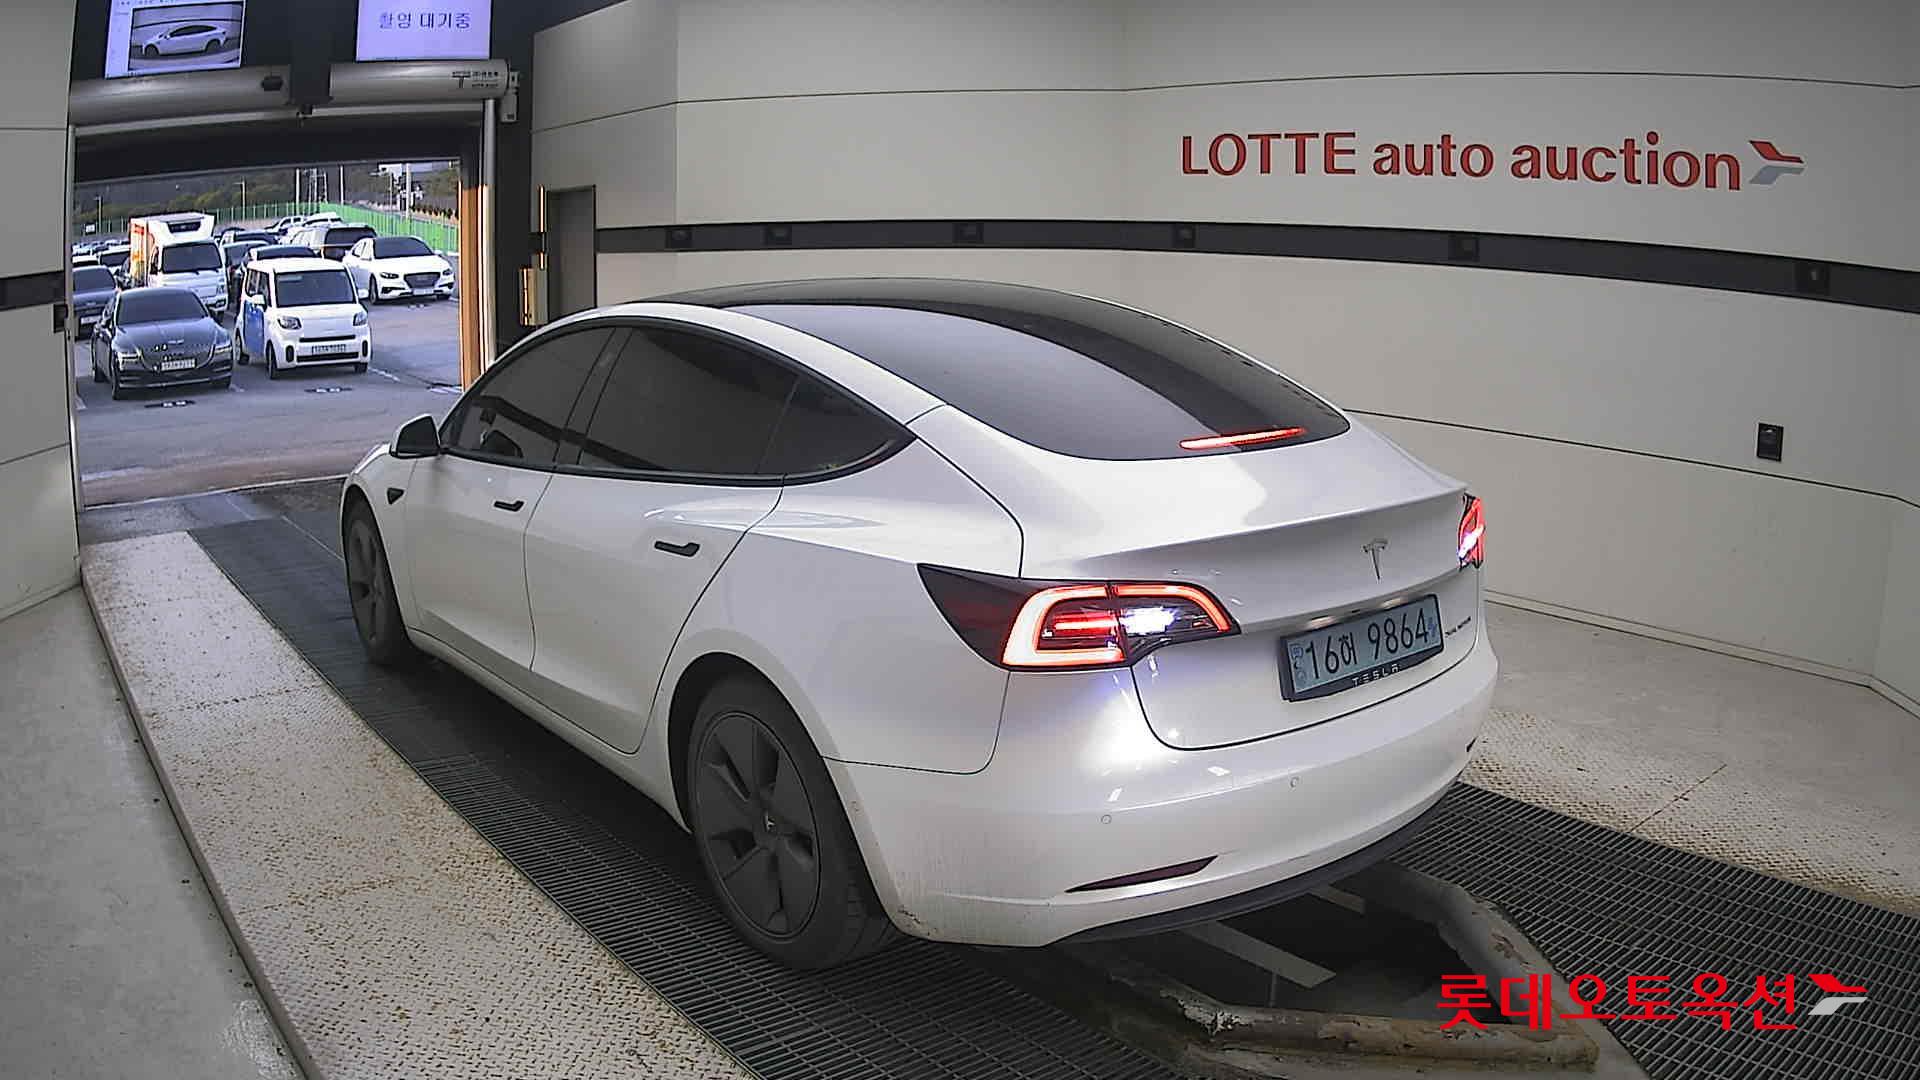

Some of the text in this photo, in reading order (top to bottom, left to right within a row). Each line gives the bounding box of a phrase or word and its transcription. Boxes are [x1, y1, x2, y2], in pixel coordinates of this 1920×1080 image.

[419, 11, 471, 29] 대기중
[1182, 131, 1741, 191] LOTTE auto auction
[1305, 631, 1358, 680] 16허
[1367, 607, 1429, 661] 9864
[1351, 663, 1401, 688] TESLA
